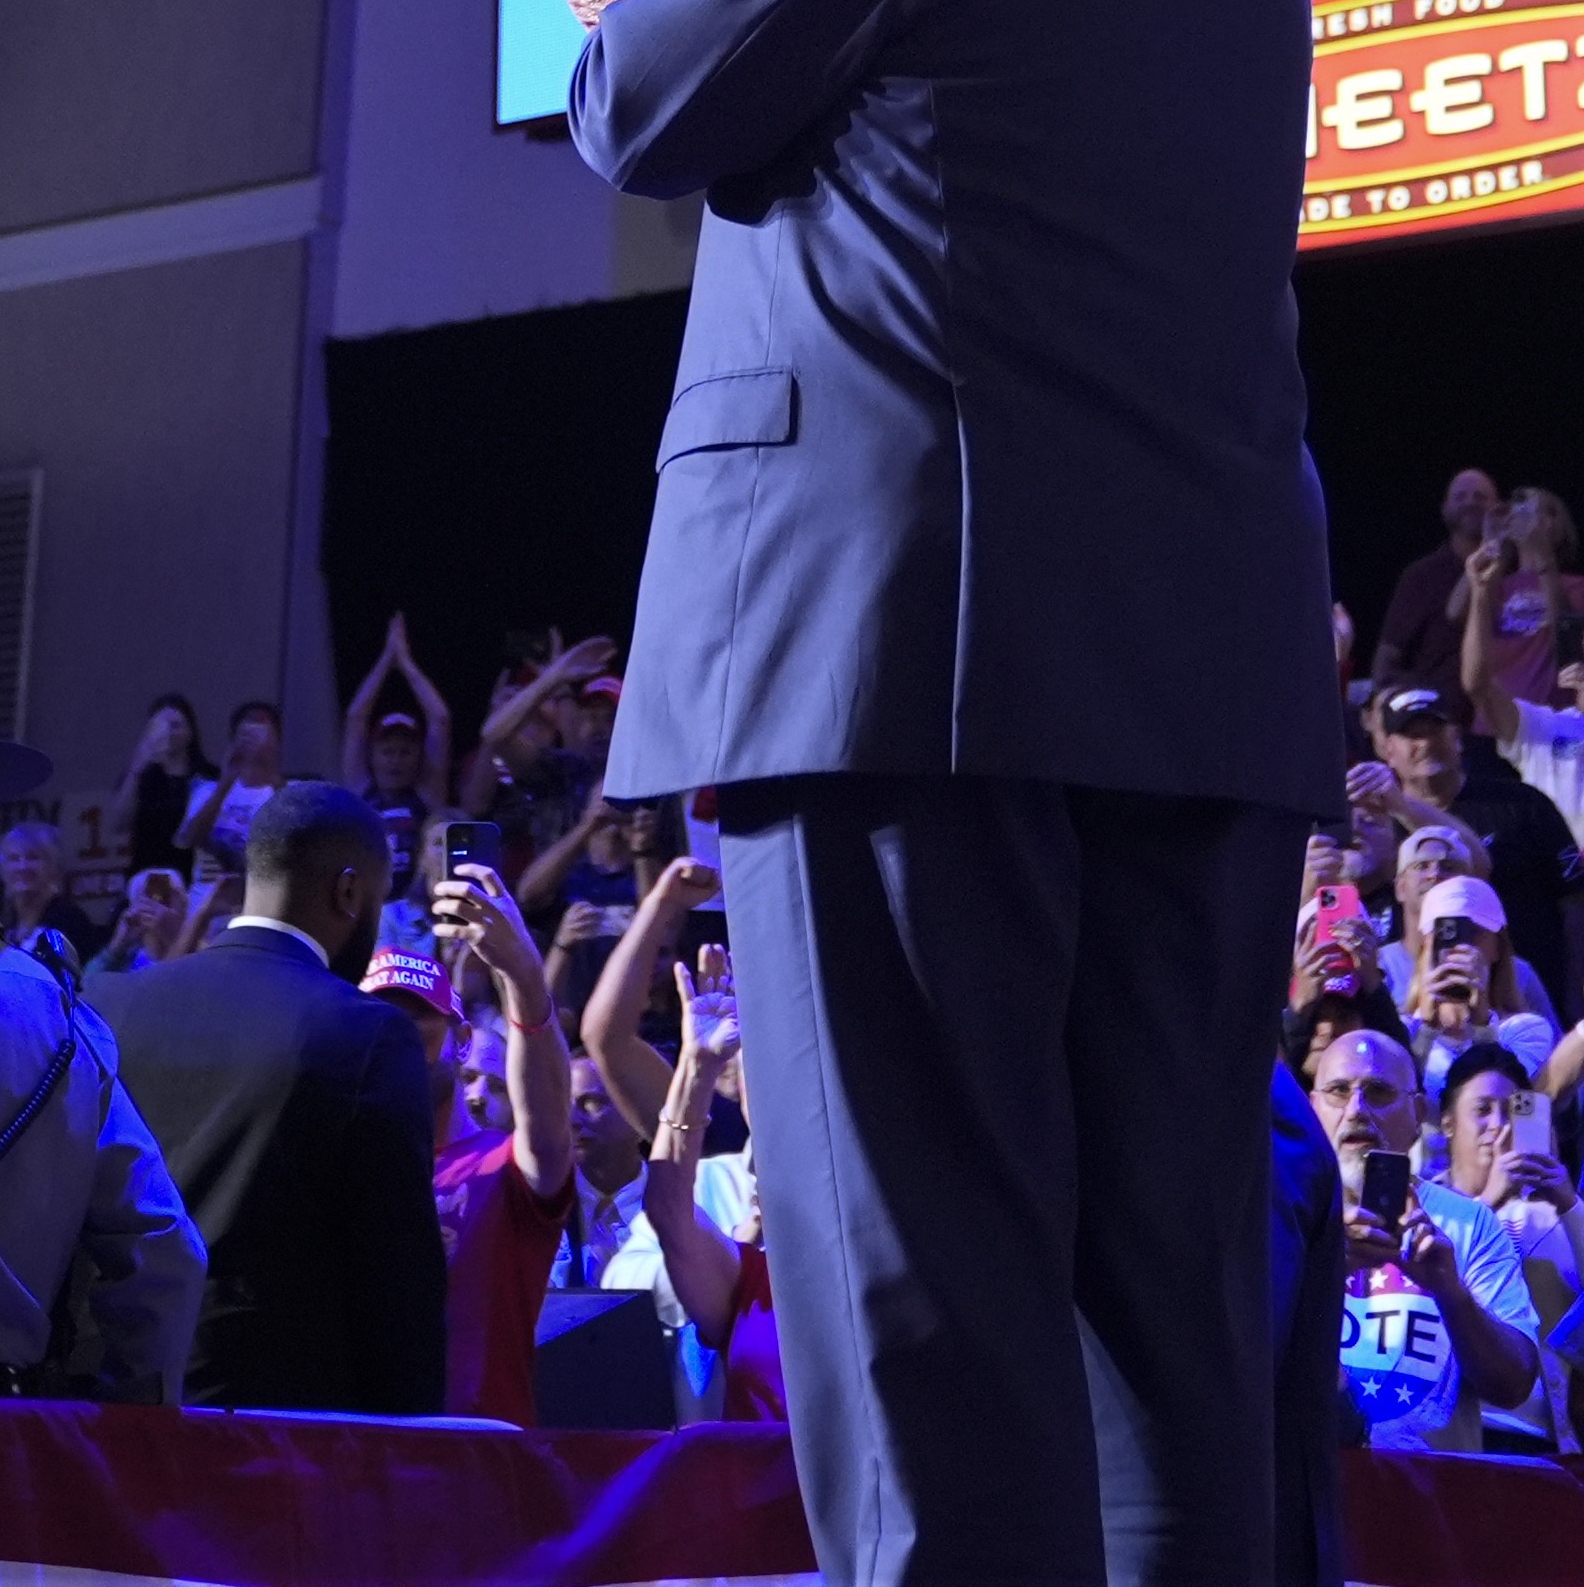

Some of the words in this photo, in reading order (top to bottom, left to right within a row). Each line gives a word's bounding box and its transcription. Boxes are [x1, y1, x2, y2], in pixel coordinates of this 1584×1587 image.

[1311, 3, 1393, 40] RESH
[1366, 186, 1411, 215] TO
[1425, 161, 1544, 205] ORDER
[389, 970, 434, 991] AGAIN
[1340, 1308, 1441, 1364] OTE
